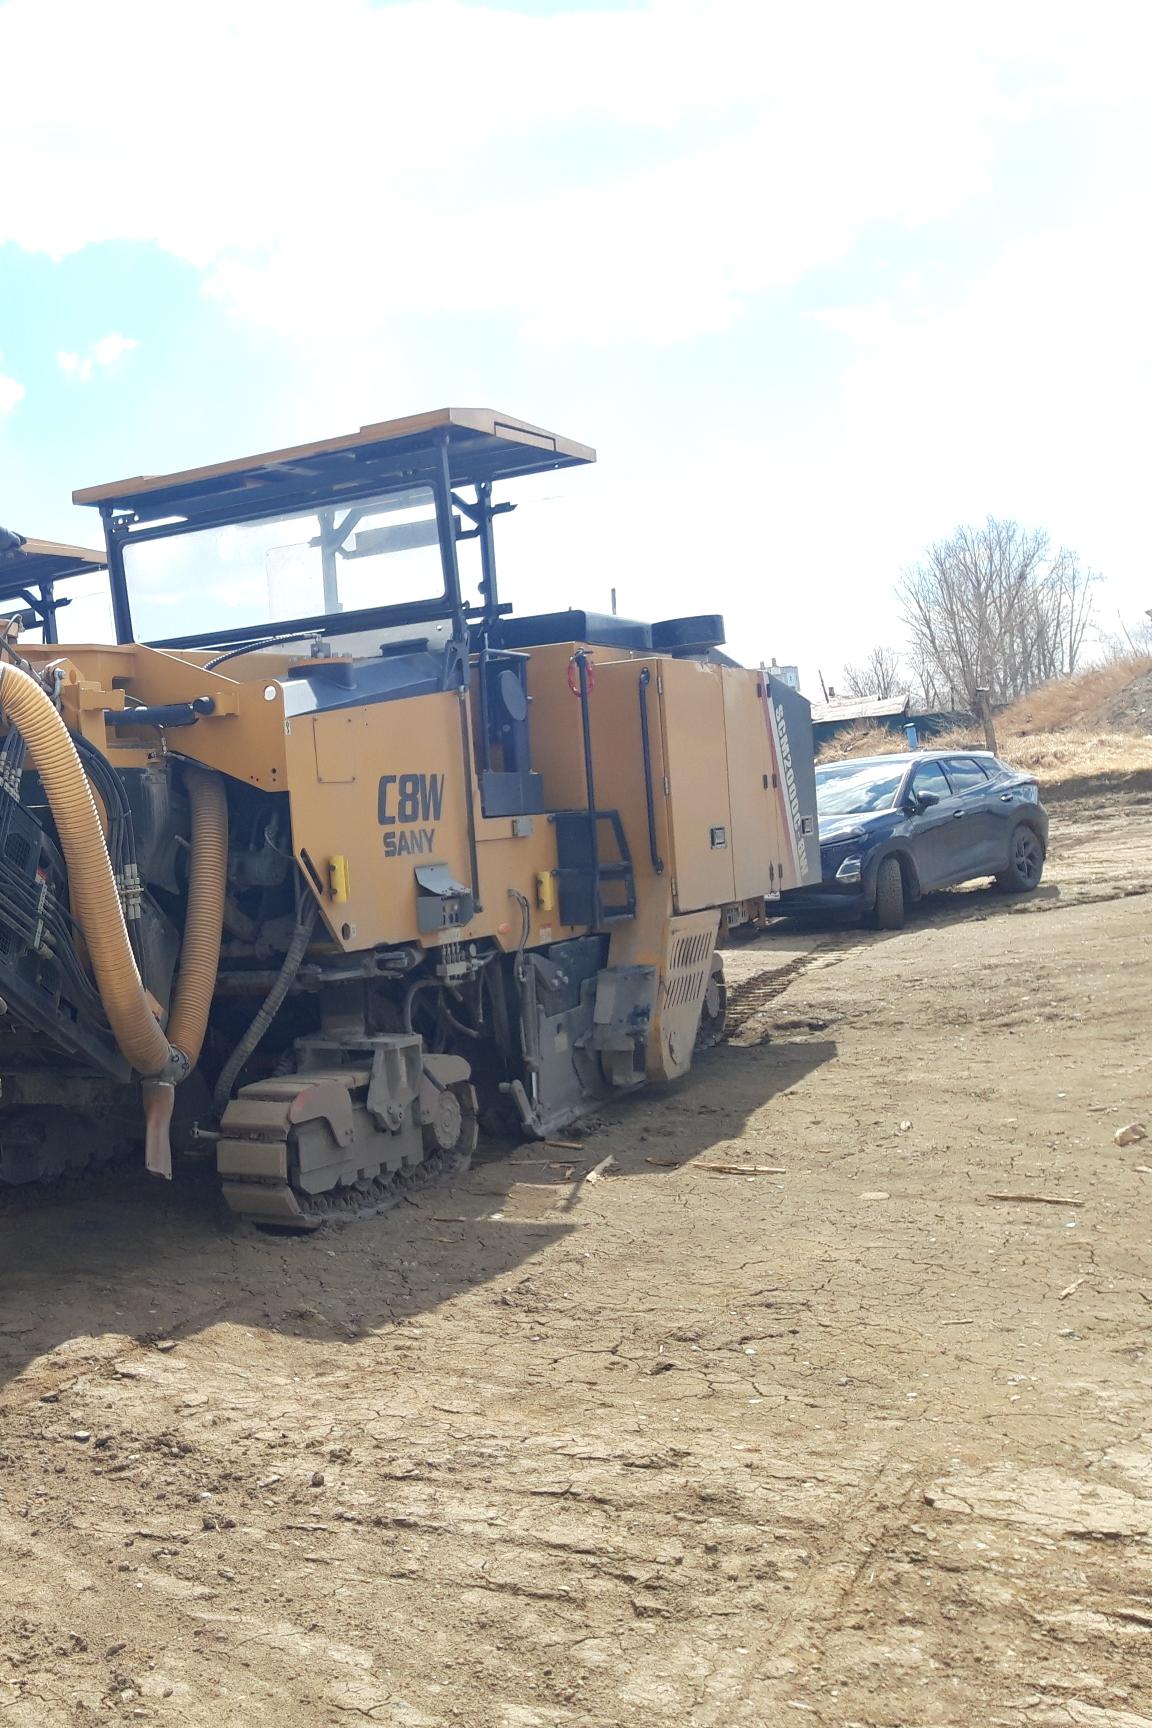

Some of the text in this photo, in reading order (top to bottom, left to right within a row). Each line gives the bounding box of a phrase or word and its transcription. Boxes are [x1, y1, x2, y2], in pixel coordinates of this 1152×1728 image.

[378, 774, 445, 825] C8W
[776, 704, 809, 876] SCM2000C-8W
[383, 829, 435, 858] SANY
